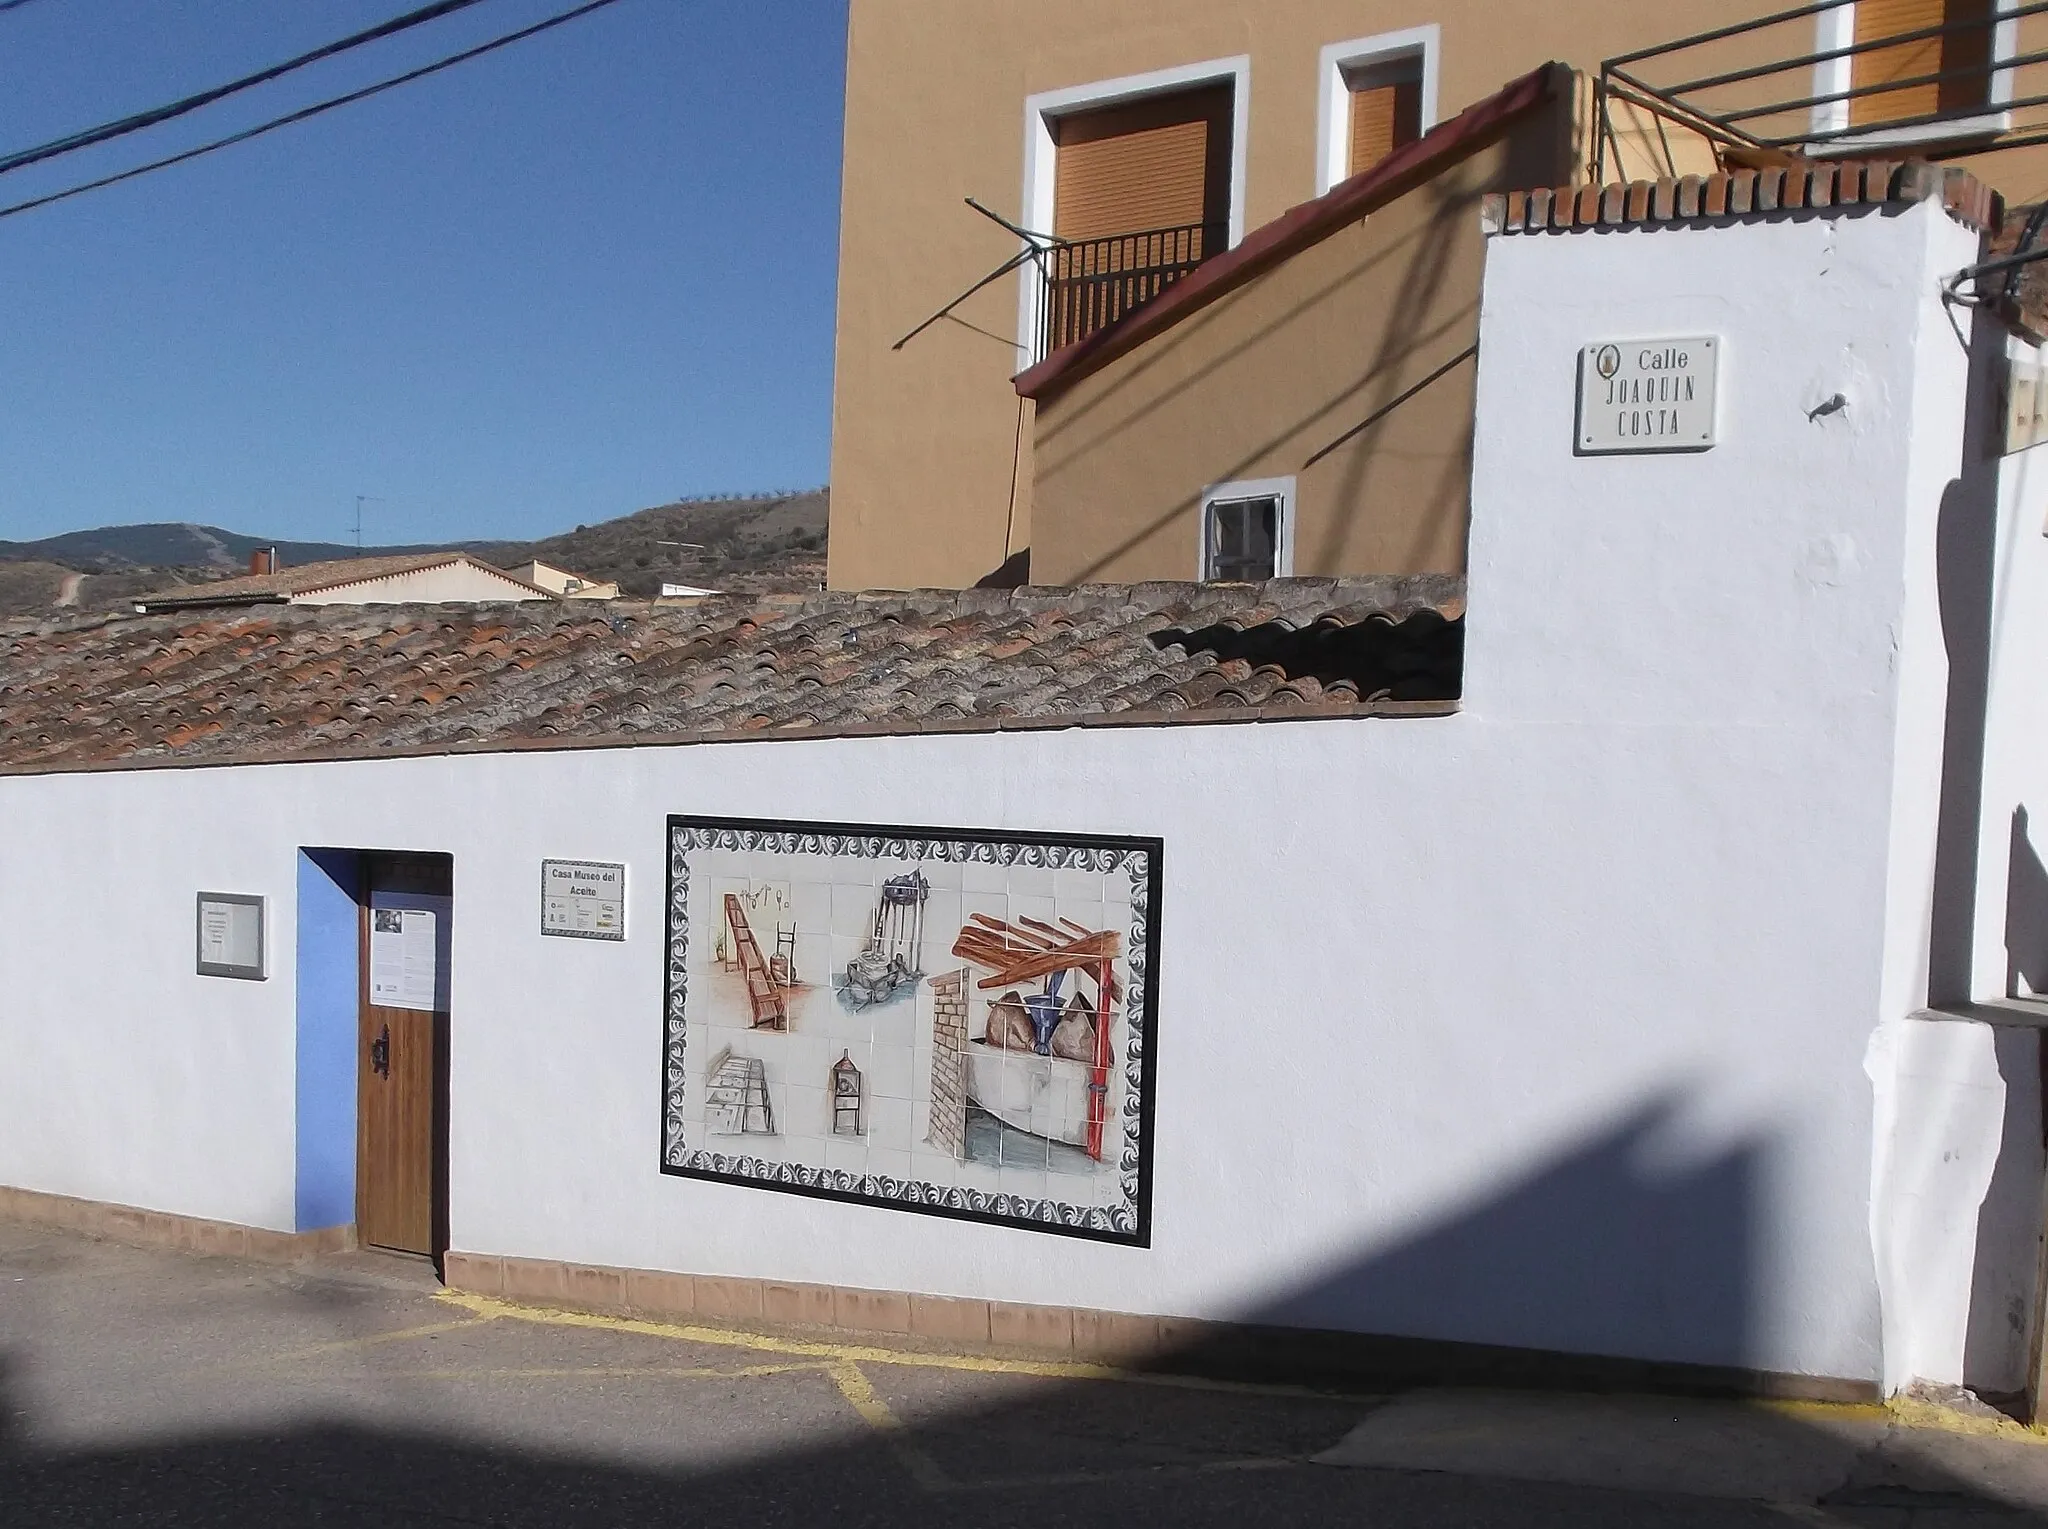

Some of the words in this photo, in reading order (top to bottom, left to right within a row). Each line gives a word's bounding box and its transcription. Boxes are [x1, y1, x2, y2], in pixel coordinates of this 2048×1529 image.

[1639, 348, 1688, 370] Calle
[1606, 375, 1695, 405] JOAQUIN
[1618, 409, 1678, 436] COSTA
[552, 868, 572, 879] Casa
[574, 870, 601, 881] Museo
[602, 872, 616, 882] del
[570, 885, 597, 896] Aceite
